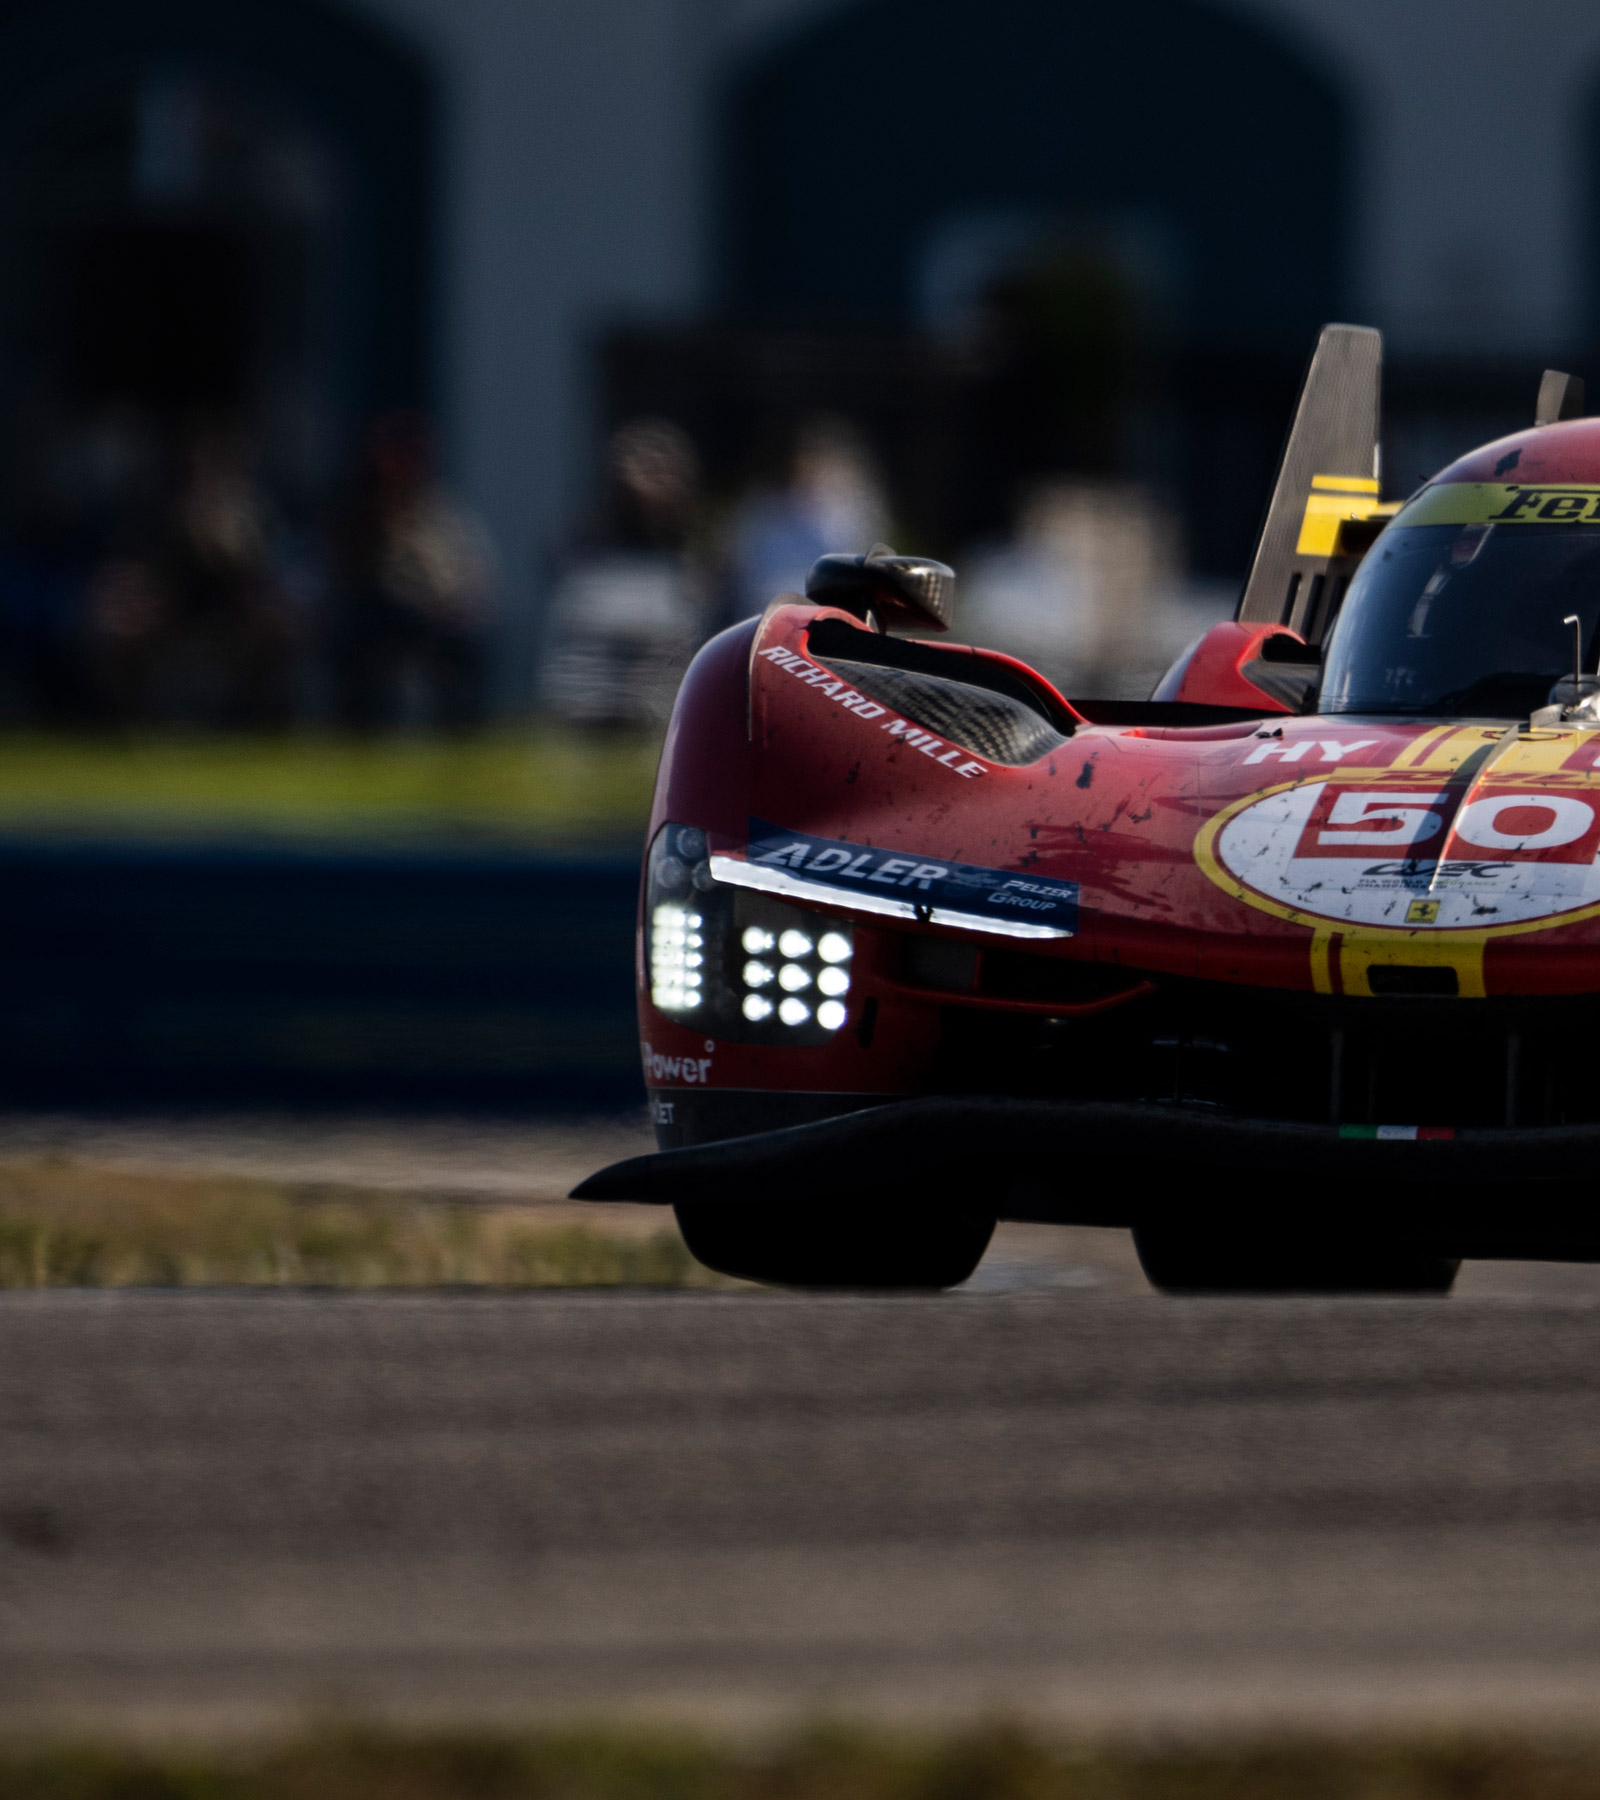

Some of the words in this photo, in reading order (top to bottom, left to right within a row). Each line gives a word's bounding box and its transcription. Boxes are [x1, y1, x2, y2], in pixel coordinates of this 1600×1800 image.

[758, 646, 887, 720] RICHARD
[880, 718, 988, 779] MILLE
[1242, 740, 1380, 765] HY
[1317, 792, 1595, 850] 50
[755, 842, 949, 890] ADLER
[988, 892, 1057, 911] GROUP
[1002, 880, 1073, 899] PELZER
